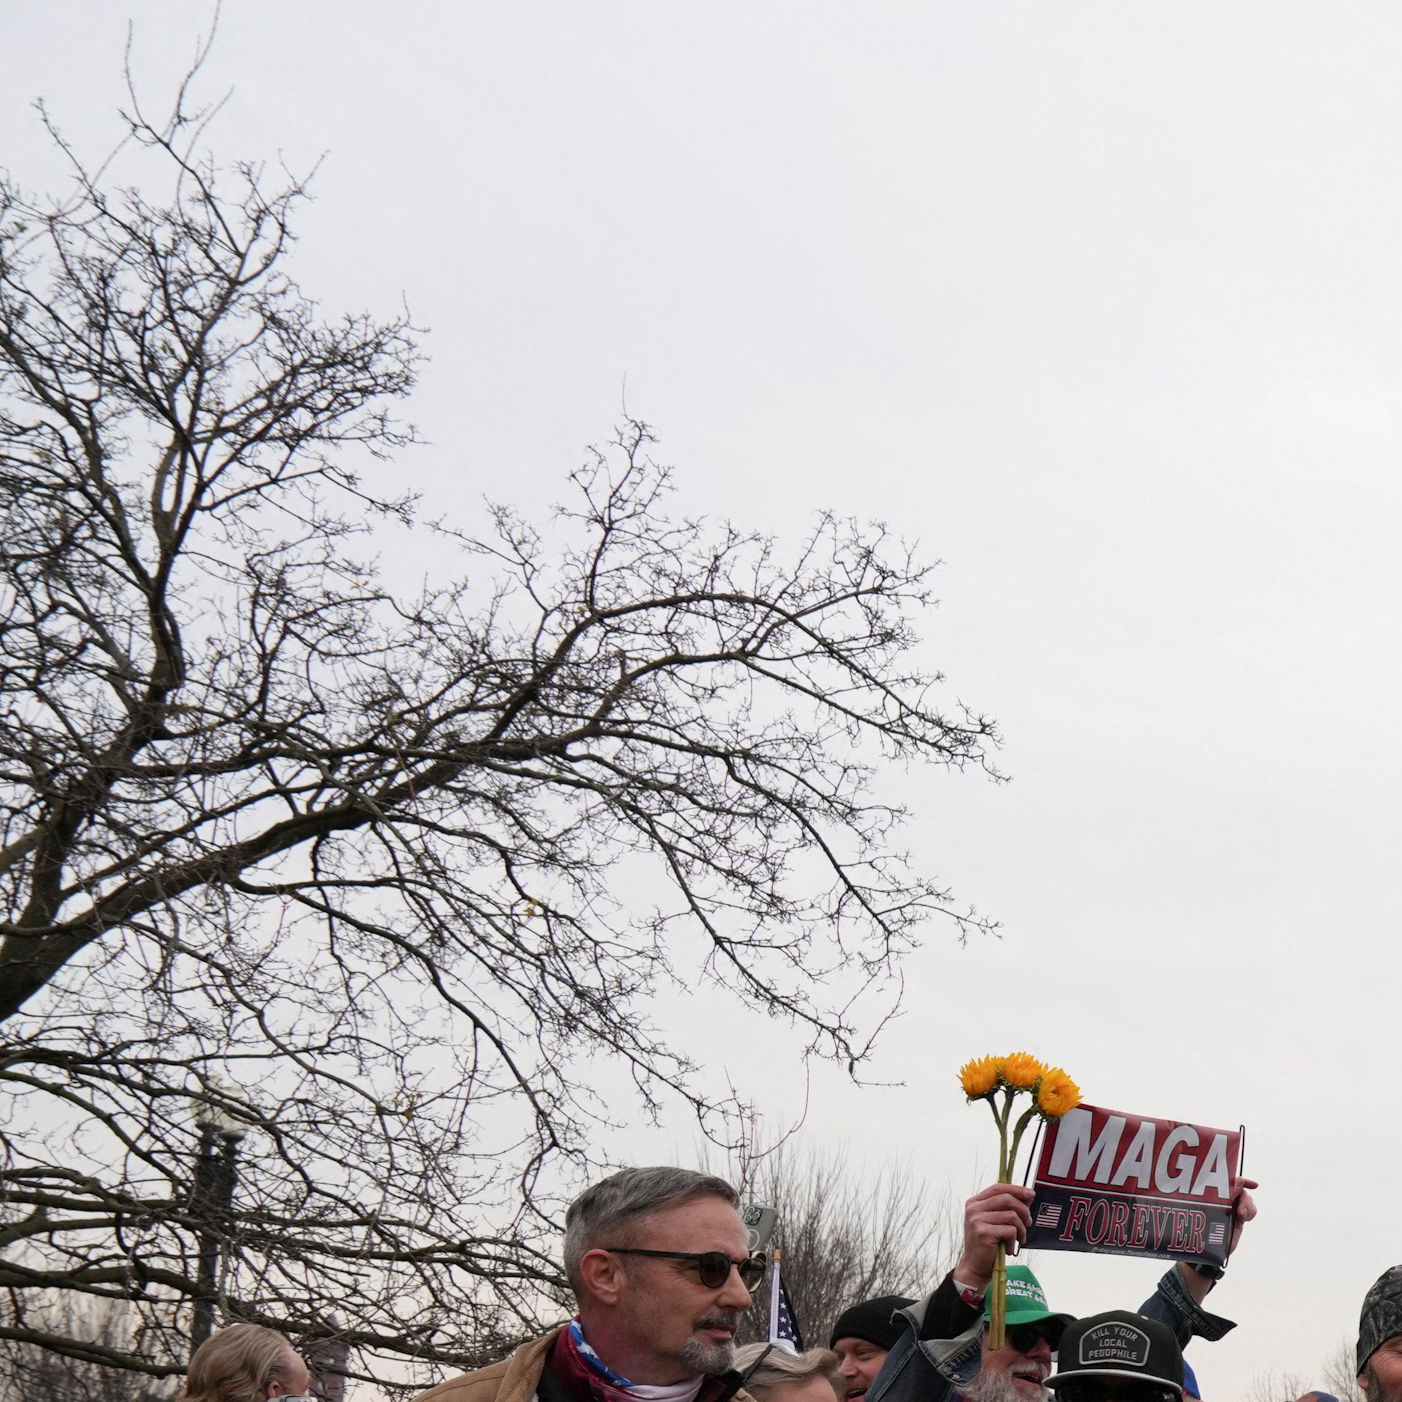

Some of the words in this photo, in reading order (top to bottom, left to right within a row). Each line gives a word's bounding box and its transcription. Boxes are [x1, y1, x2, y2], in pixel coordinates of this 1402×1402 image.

[1048, 1107, 1231, 1200] MAGA
[1059, 1195, 1208, 1254] FOREVER
[1006, 1279, 1027, 1288] AKE
[1091, 1328, 1110, 1341] KILL
[1113, 1327, 1138, 1341] YOUR
[1099, 1339, 1127, 1348] LOCAL
[1088, 1350, 1138, 1361] PEDOPHILE
